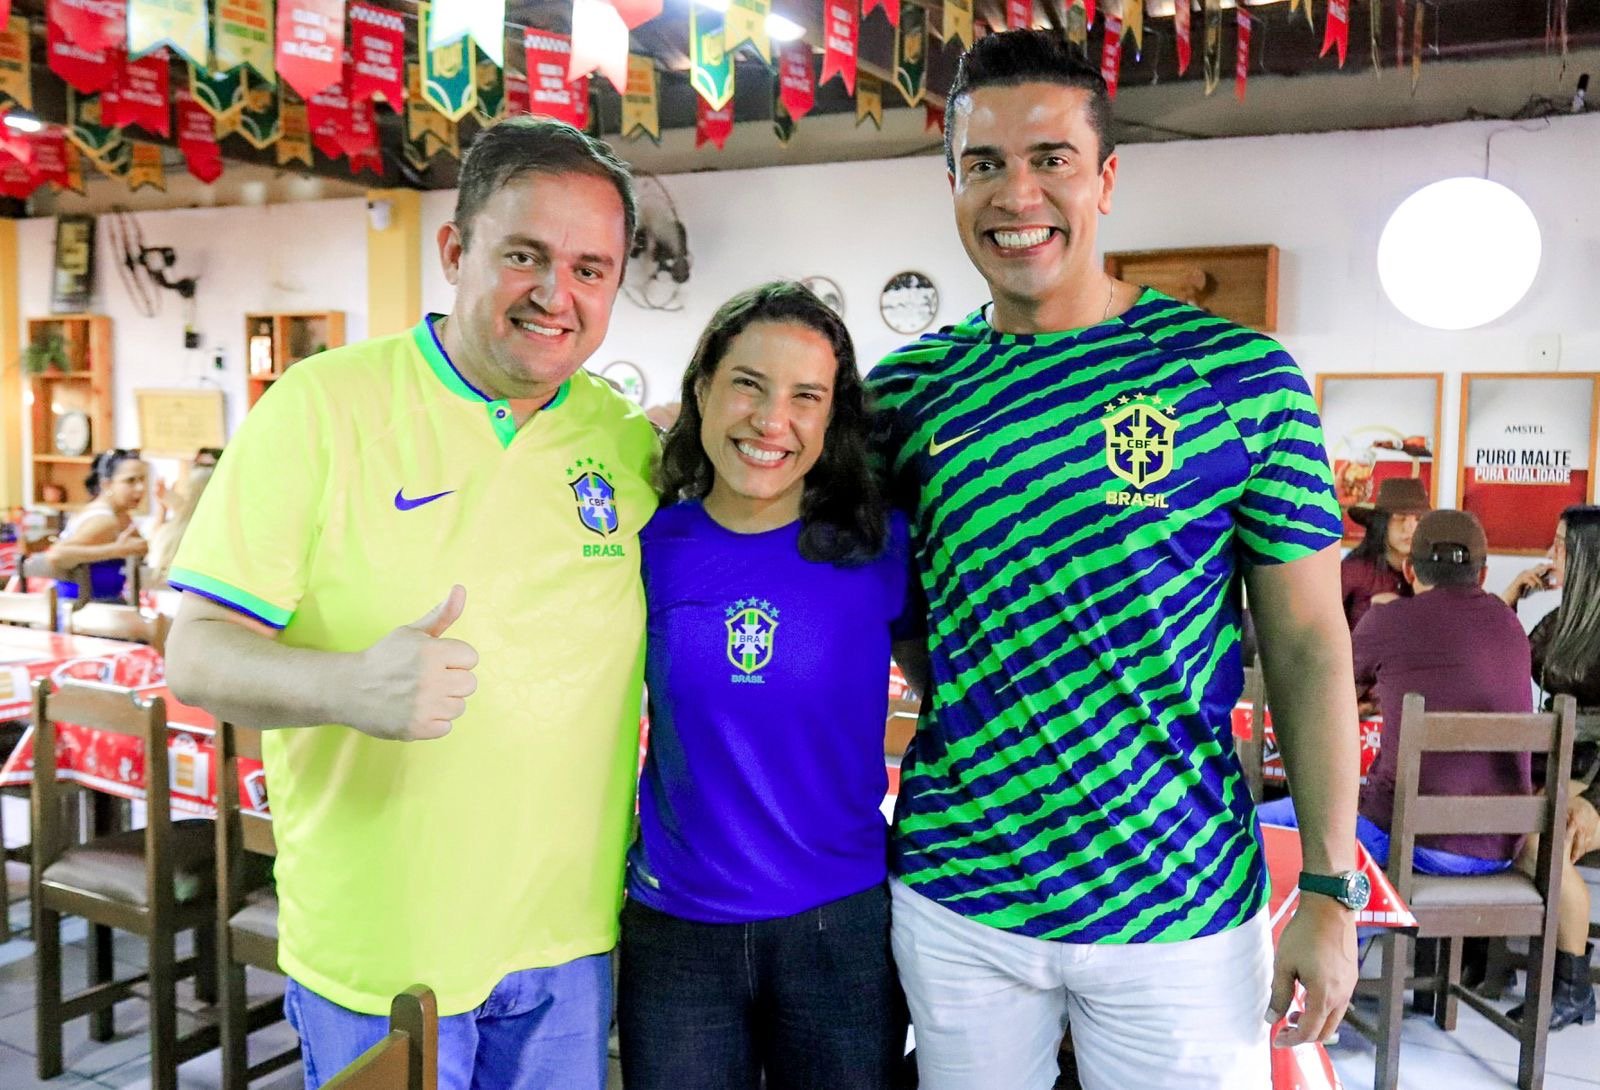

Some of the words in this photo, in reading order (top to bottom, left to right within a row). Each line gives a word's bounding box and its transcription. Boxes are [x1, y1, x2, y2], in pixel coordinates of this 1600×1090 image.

[1504, 425, 1544, 434] AMSTEL
[1127, 439, 1151, 449] CBF
[1476, 448, 1516, 466] PURO
[1521, 449, 1572, 467] MALTE
[1476, 468, 1505, 482] PURA
[1507, 468, 1571, 484] QUALIDADE
[589, 498, 605, 507] CBF
[1105, 491, 1169, 508] BRASIL
[582, 544, 625, 557] BRASIL
[739, 634, 761, 643] BRA
[731, 674, 765, 684] BRASIL
